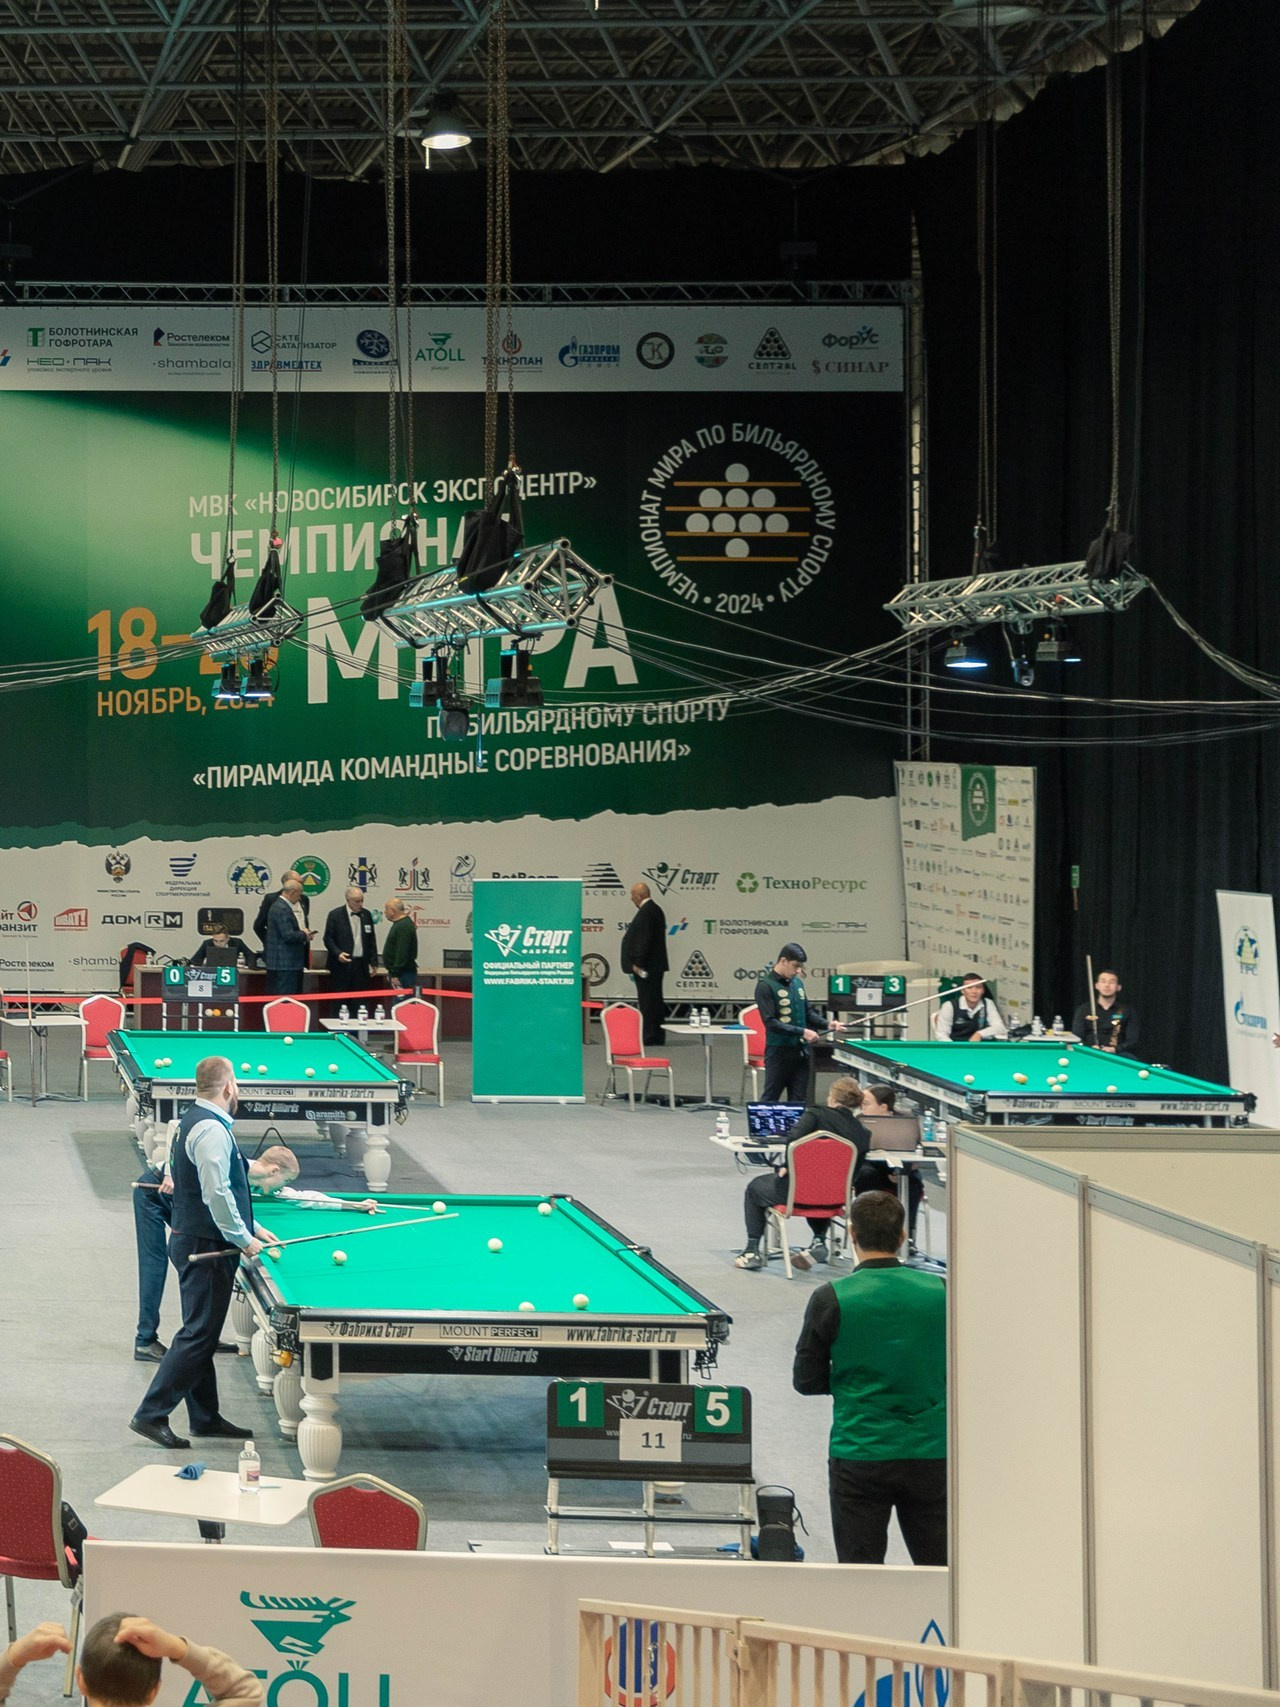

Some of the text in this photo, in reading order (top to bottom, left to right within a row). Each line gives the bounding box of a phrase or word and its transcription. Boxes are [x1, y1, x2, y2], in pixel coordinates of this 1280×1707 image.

[48, 327, 138, 337] БОЛОТНИНСКАЯ
[167, 332, 230, 344] Ростелеком
[48, 339, 113, 348] ГОФРОТАРА
[748, 362, 797, 370] CENTRAL
[189, 488, 237, 520] МВК
[639, 423, 837, 604] ЧЕМПИОНАТ МИРА ПО БИЛЬЯРДНОМУ СПОРТУ
[714, 593, 765, 615] 2024
[96, 687, 206, 718] НОЯБРЬ,
[466, 695, 731, 739] БИЛЬЯРДНОМУ СПОРТУ
[193, 739, 692, 791] «ПИРАМИДА КОМАНДНЫЕ СОРЕВНОВАНИЯ»
[680, 869, 720, 888] Старт
[763, 876, 868, 894] ТехноРесурс
[101, 915, 142, 925] ДОМ
[720, 919, 789, 928] БОЛОТНИНСКАЯ
[522, 926, 573, 951] Старт
[720, 928, 769, 936] ГОФРОТАРА
[483, 961, 575, 970] ОФИЦИАЛЬНЫЙ ПАРТНЕР
[169, 969, 180, 983] 0
[220, 969, 231, 983] 5
[835, 978, 844, 992] 1
[888, 977, 900, 993] 3
[254, 1102, 271, 1113] Start
[339, 1322, 414, 1340] Фабрика Старт
[442, 1326, 539, 1338] MOUNT PERFECT
[566, 1326, 677, 1346] www.fabrika-start.ru
[464, 1346, 539, 1365] Start Billiards
[569, 1386, 587, 1422] 1
[646, 1397, 692, 1420] Старт
[705, 1391, 730, 1427] 5
[641, 1432, 666, 1449] 11
